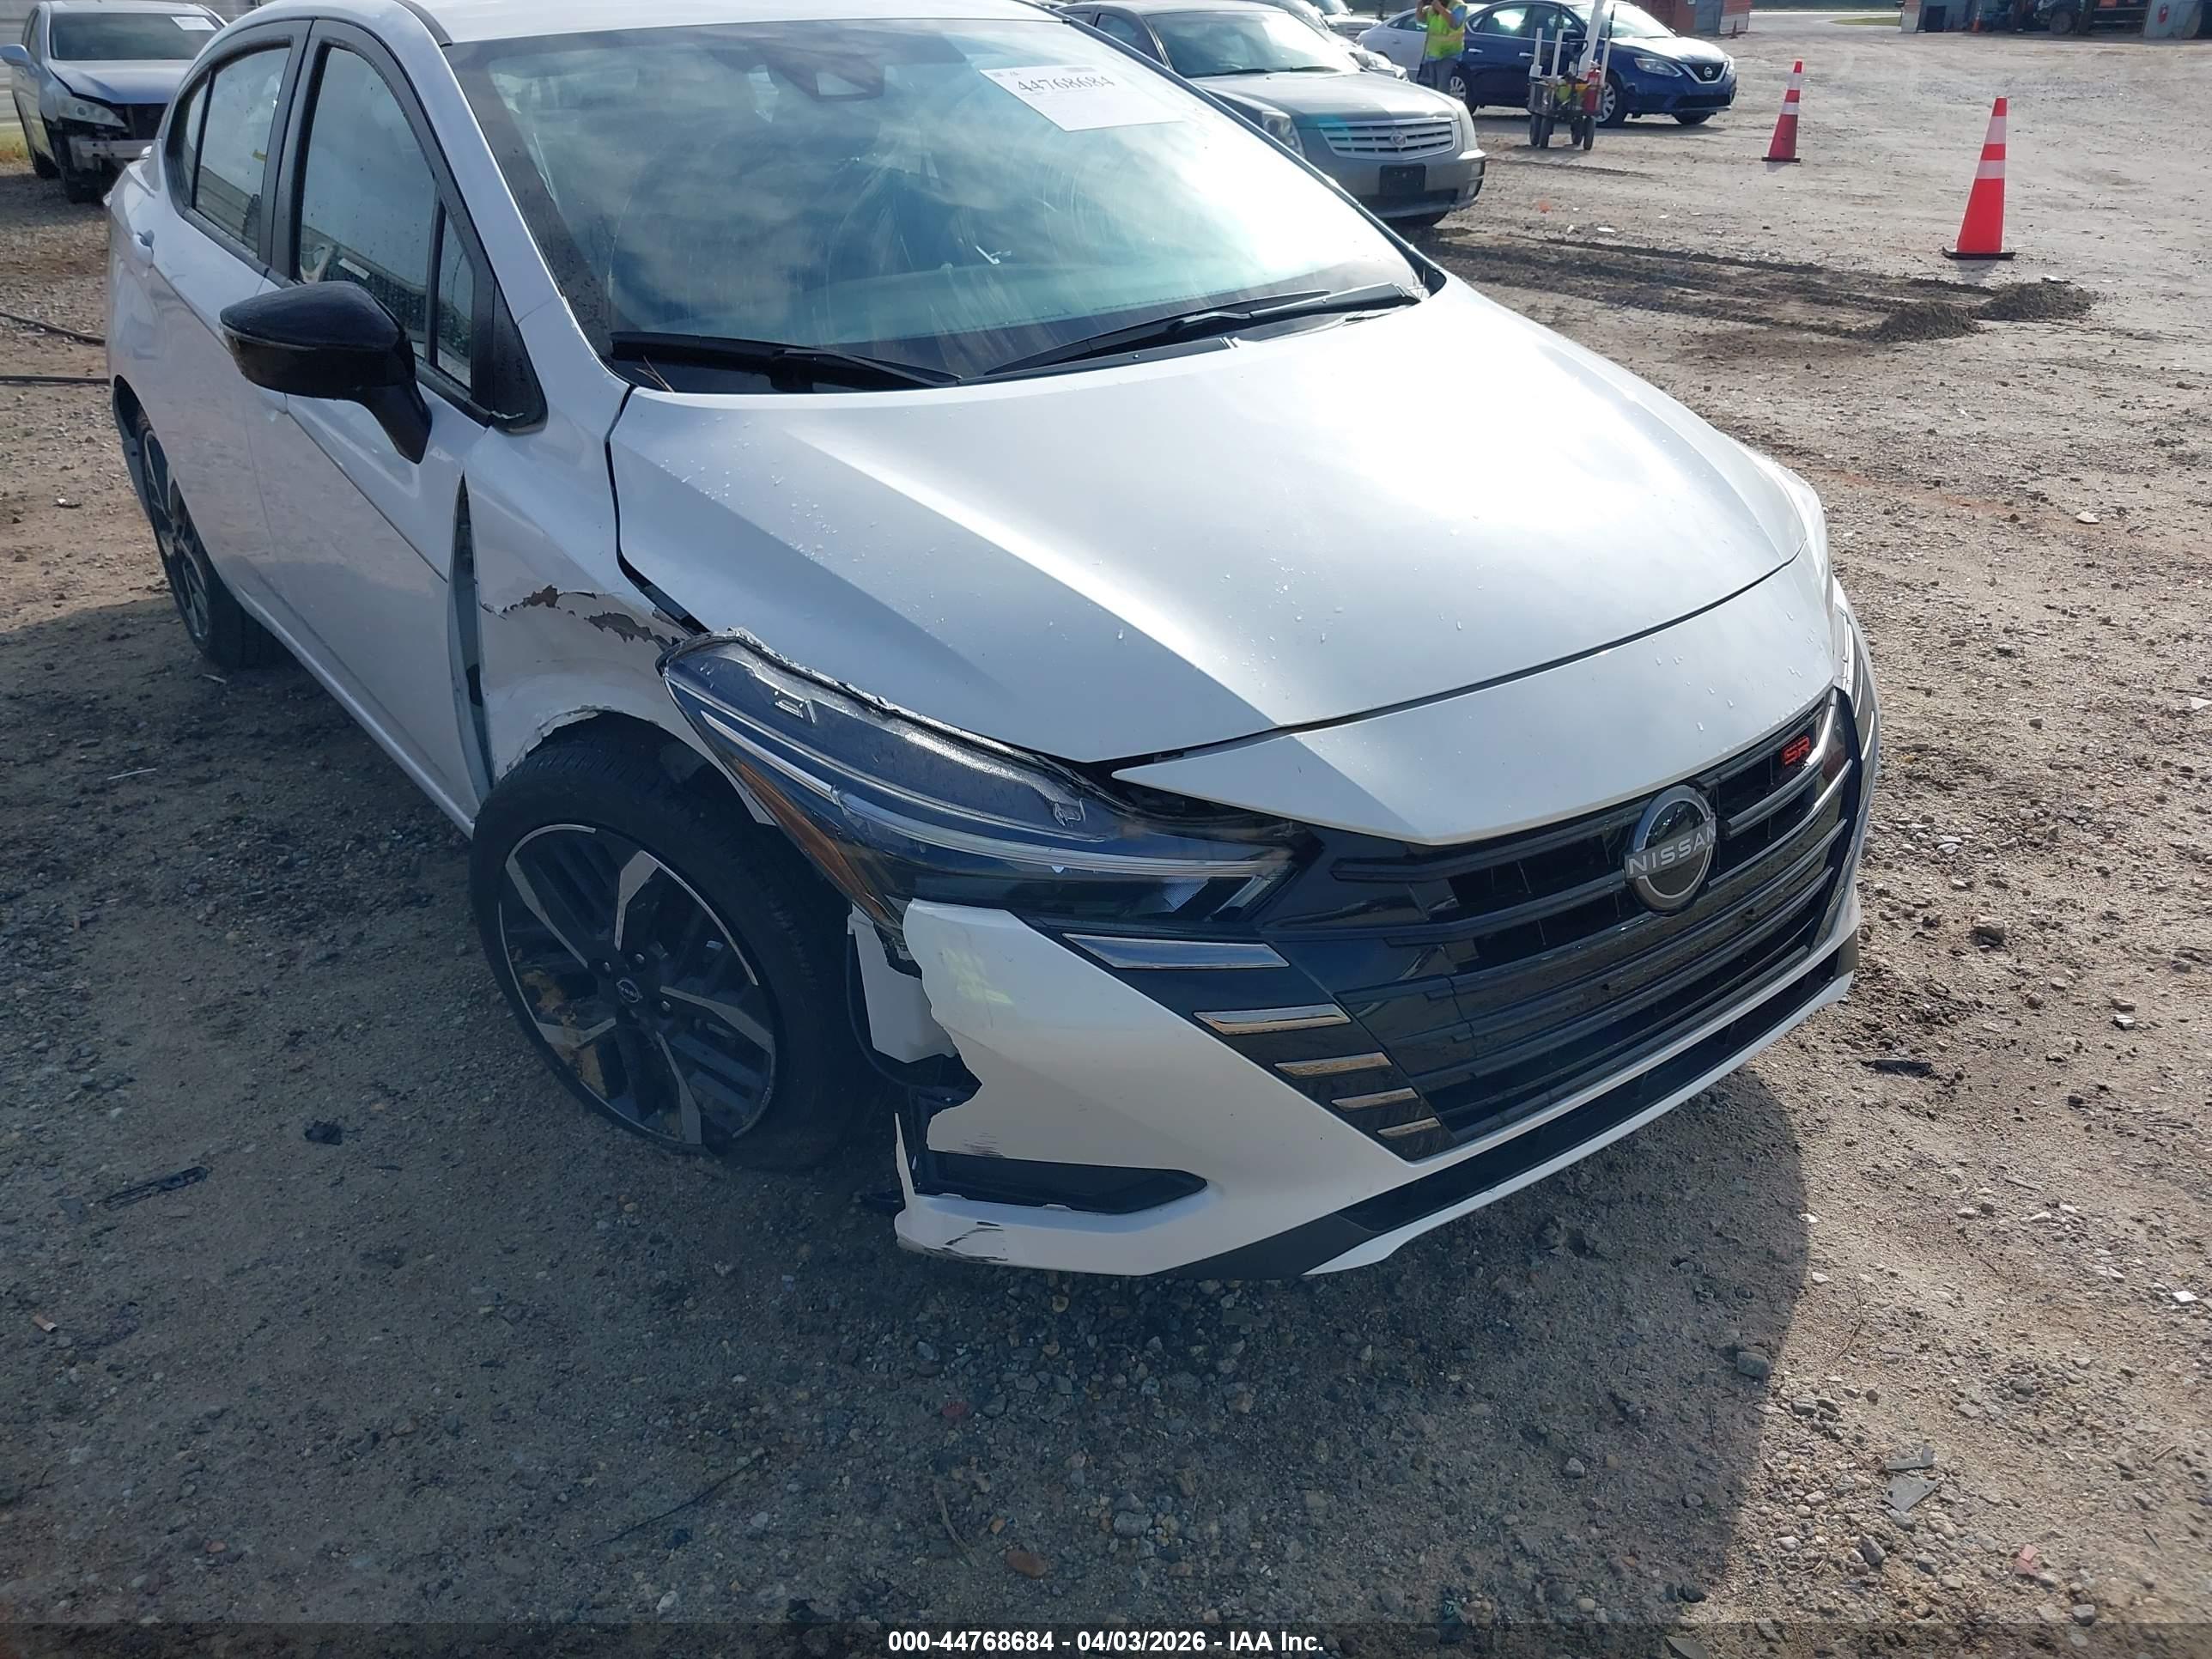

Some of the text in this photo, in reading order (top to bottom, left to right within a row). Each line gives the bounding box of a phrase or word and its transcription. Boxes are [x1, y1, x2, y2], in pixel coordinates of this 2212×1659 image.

[1018, 76, 1115, 92] 44768684
[1783, 736, 1811, 766] SR
[1628, 825, 1717, 875] NISSAN
